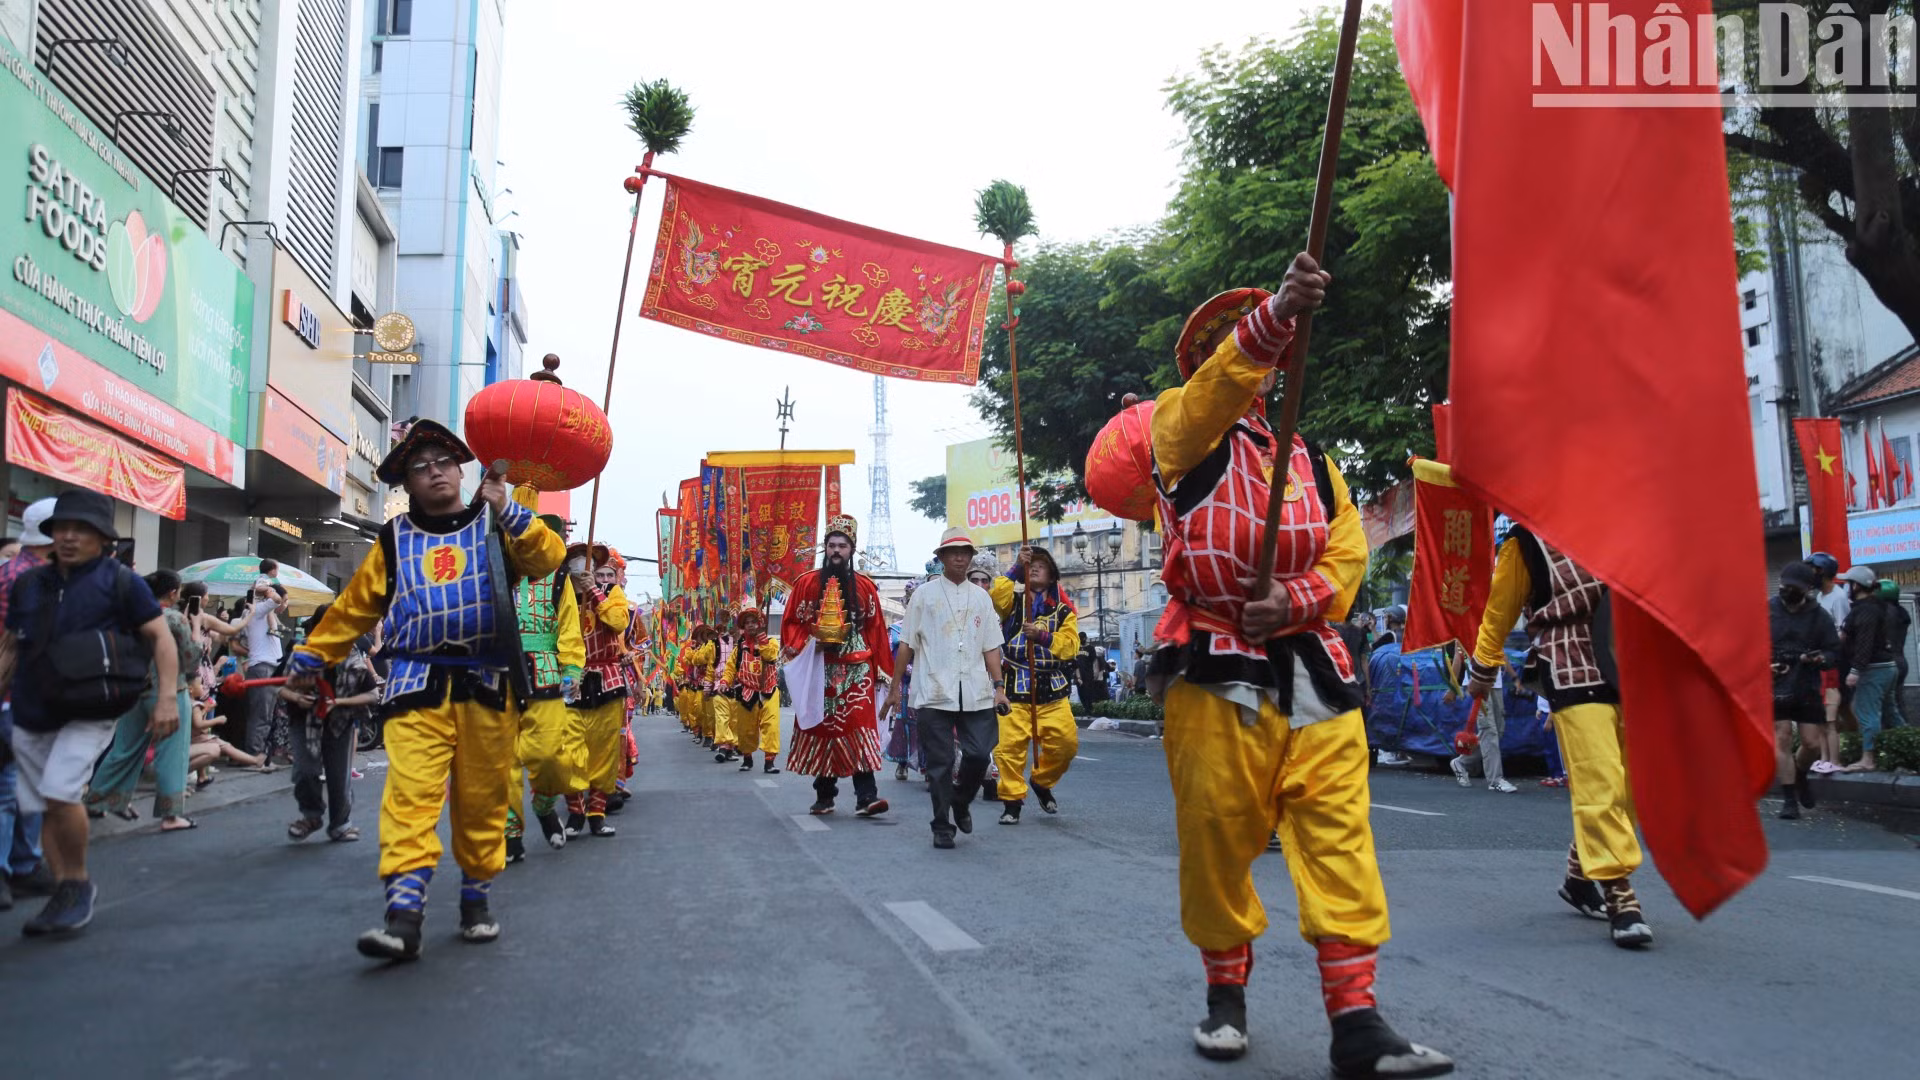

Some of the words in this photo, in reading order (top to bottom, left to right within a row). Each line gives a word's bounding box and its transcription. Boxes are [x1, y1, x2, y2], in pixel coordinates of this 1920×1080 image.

[11, 57, 34, 91] CÔNG
[34, 79, 46, 101] TY
[30, 143, 108, 235] SATRA
[25, 185, 108, 272] FOODS
[14, 254, 41, 292] CỬA
[40, 272, 75, 315] HÀNG
[75, 294, 104, 333] THỰC
[103, 316, 133, 352] PHẨM
[131, 332, 153, 365] TIỆN
[151, 347, 167, 375] LỢI
[369, 352, 417, 362] ToCoToCo
[82, 390, 101, 413] CỬA
[101, 401, 123, 425] HÀNG
[124, 413, 142, 434] BÌNH
[153, 427, 164, 447] THỊ
[104, 380, 115, 400] TỰ
[130, 392, 149, 414] HÀNG
[433, 546, 457, 582] 勇
